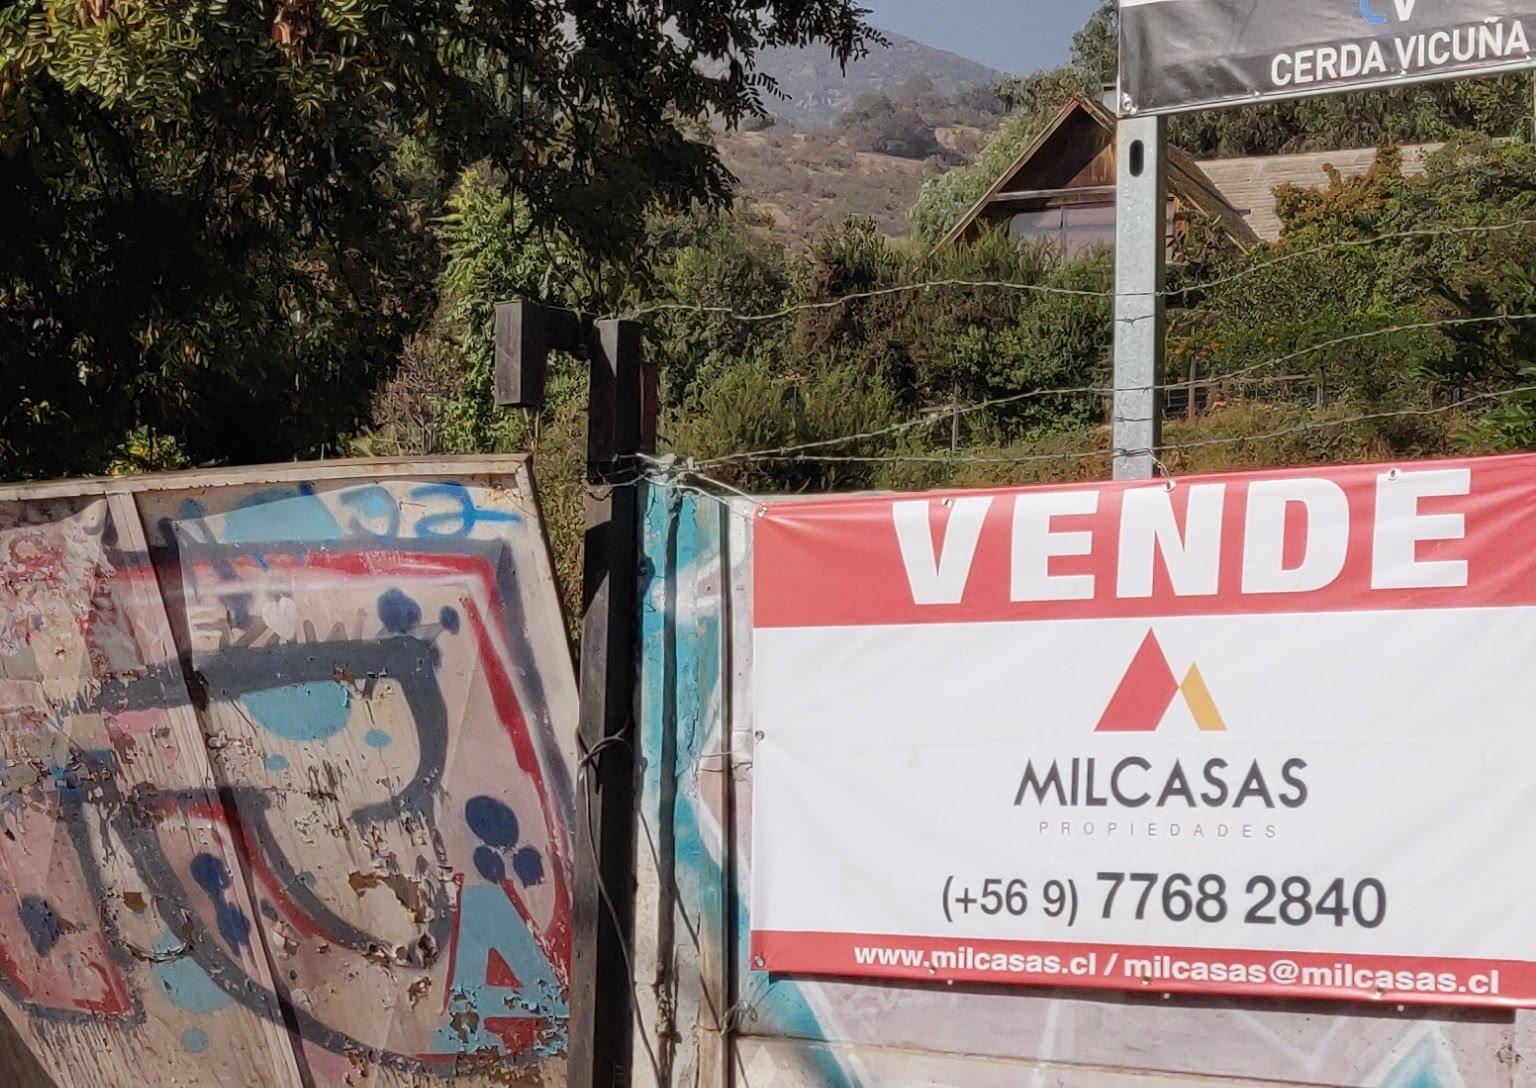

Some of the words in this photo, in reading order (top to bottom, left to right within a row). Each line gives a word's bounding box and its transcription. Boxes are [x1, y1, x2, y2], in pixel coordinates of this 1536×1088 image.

[1271, 41, 1387, 87] CERDA
[1394, 16, 1531, 71] VICUÑA
[892, 468, 1471, 604] VENDE
[1013, 756, 1309, 809] MILCASAS
[1039, 820, 1277, 839] PROPIEDADES
[941, 875, 1028, 922] (+56
[1042, 879, 1079, 927] 9)
[1096, 872, 1229, 923] 7768
[1244, 876, 1388, 929] 2840
[854, 944, 1097, 977] www.milcasas.cl
[1104, 955, 1118, 978] /
[1123, 957, 1500, 995] milcasas@milcasas.cl
